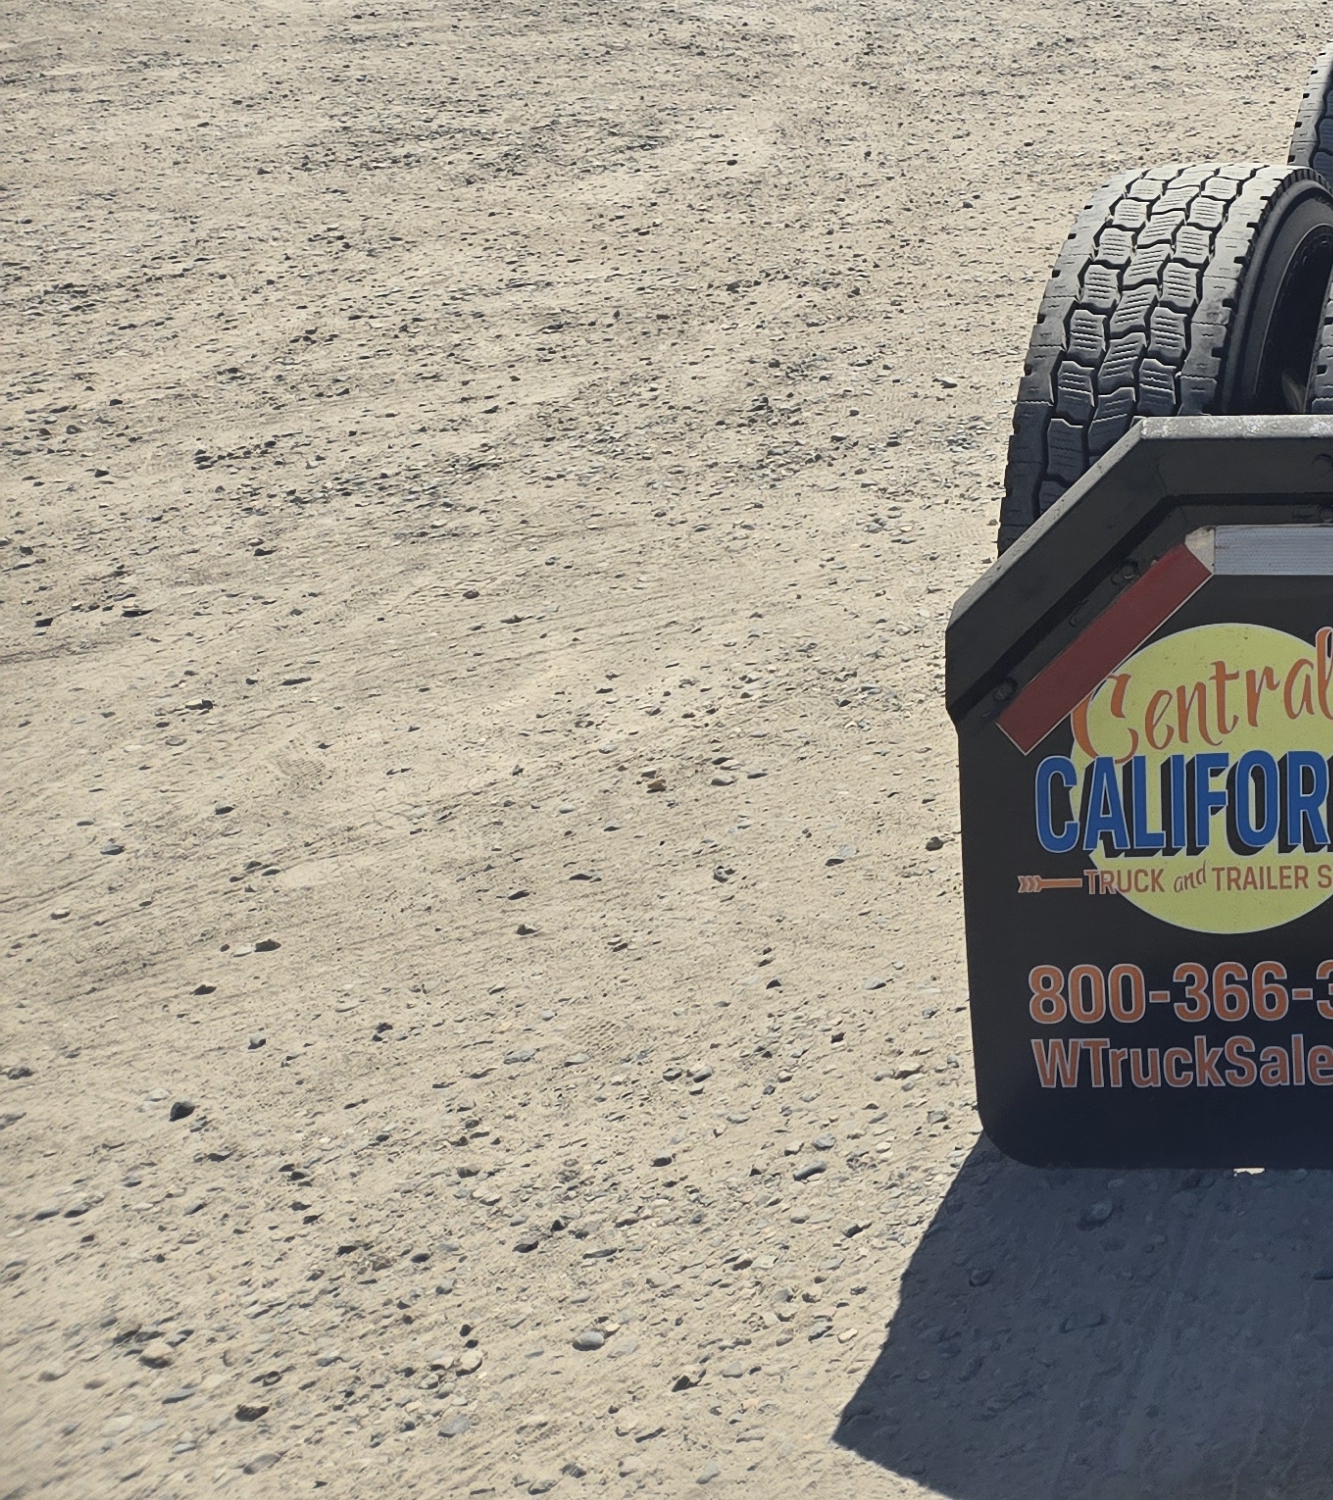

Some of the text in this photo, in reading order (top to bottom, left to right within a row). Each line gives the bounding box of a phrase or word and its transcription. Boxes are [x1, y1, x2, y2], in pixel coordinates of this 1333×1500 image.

[1083, 867, 1165, 895] TRUCK
[1173, 860, 1208, 893] and
[1212, 865, 1309, 891] TRAILER
